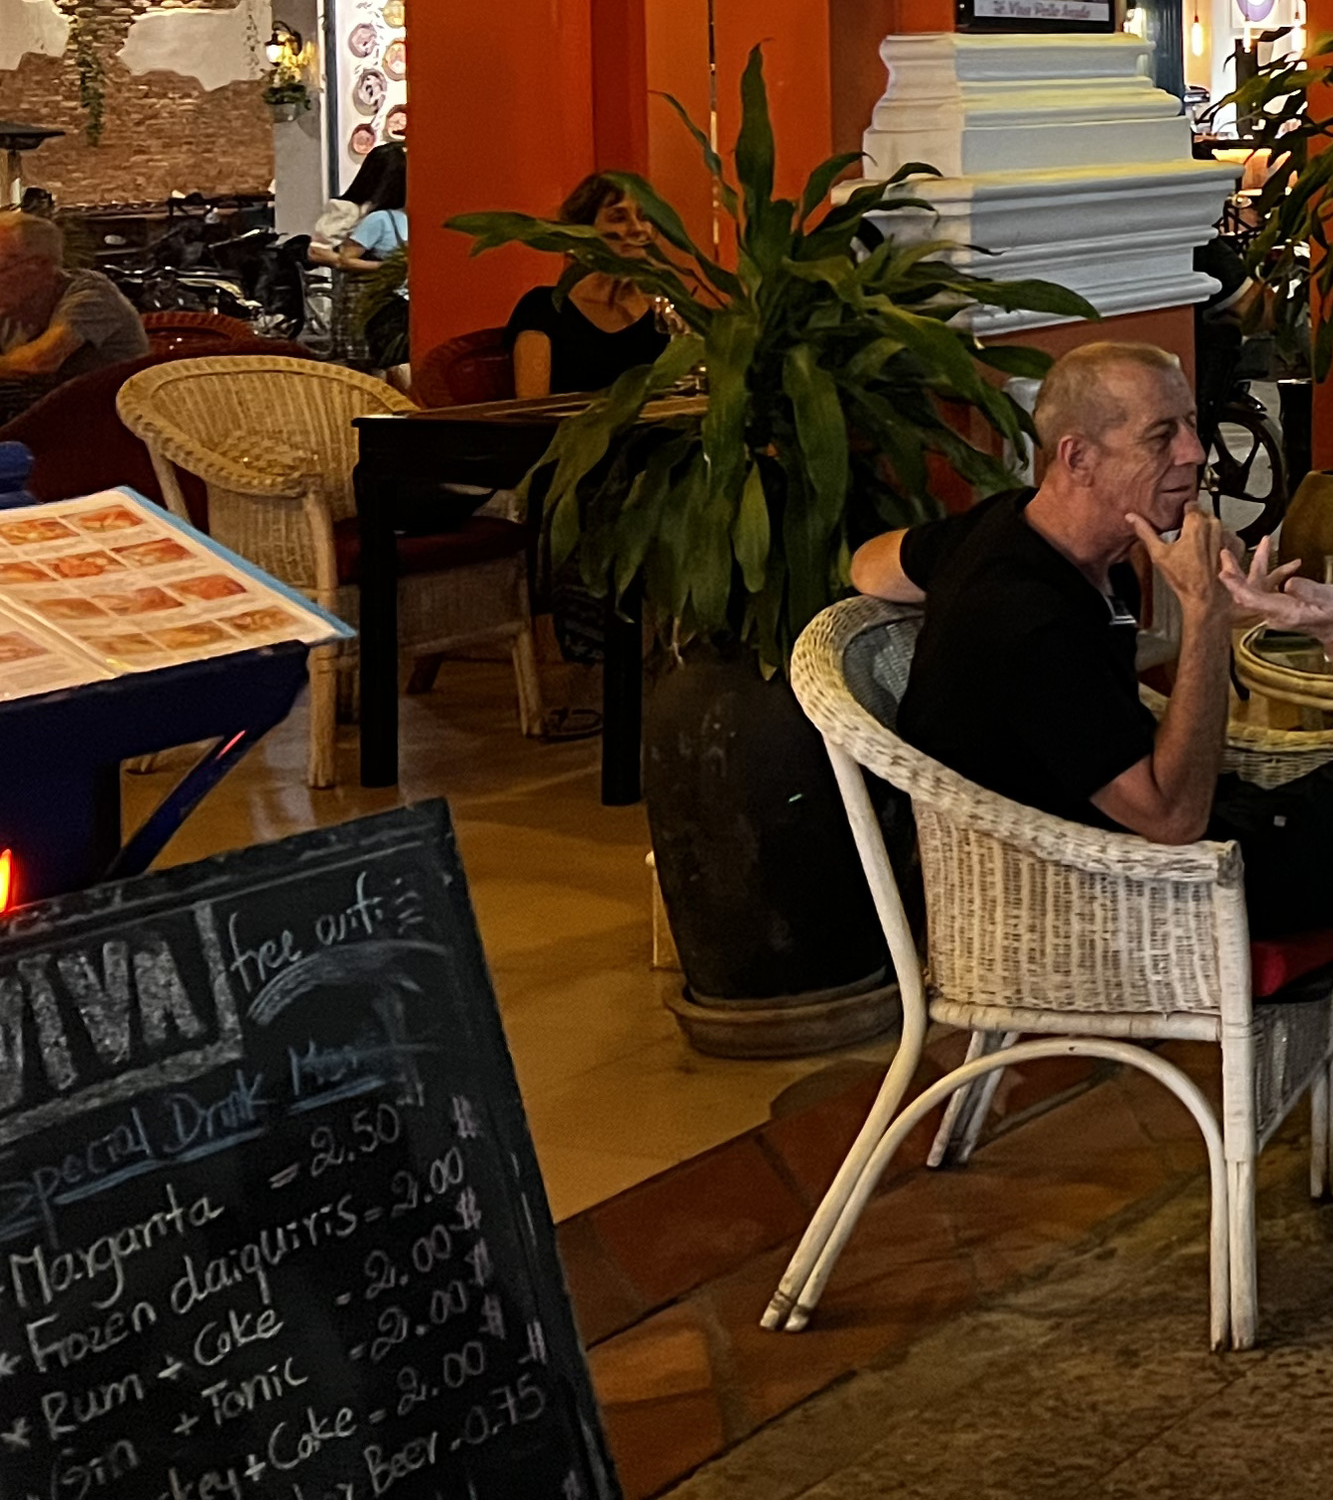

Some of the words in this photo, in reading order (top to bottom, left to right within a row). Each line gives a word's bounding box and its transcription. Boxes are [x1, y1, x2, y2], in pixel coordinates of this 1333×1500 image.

[228, 911, 304, 994] free
[168, 1069, 265, 1150] Drink
[9, 1183, 225, 1308] Margarita
[309, 1103, 401, 1177] 2.50
[26, 1301, 157, 1374] Frozen
[42, 1372, 144, 1441] Rum
[193, 1308, 286, 1367] Coke
[201, 1355, 311, 1426] Tonic
[267, 1405, 358, 1470] Coke
[364, 1430, 439, 1498] Beer
